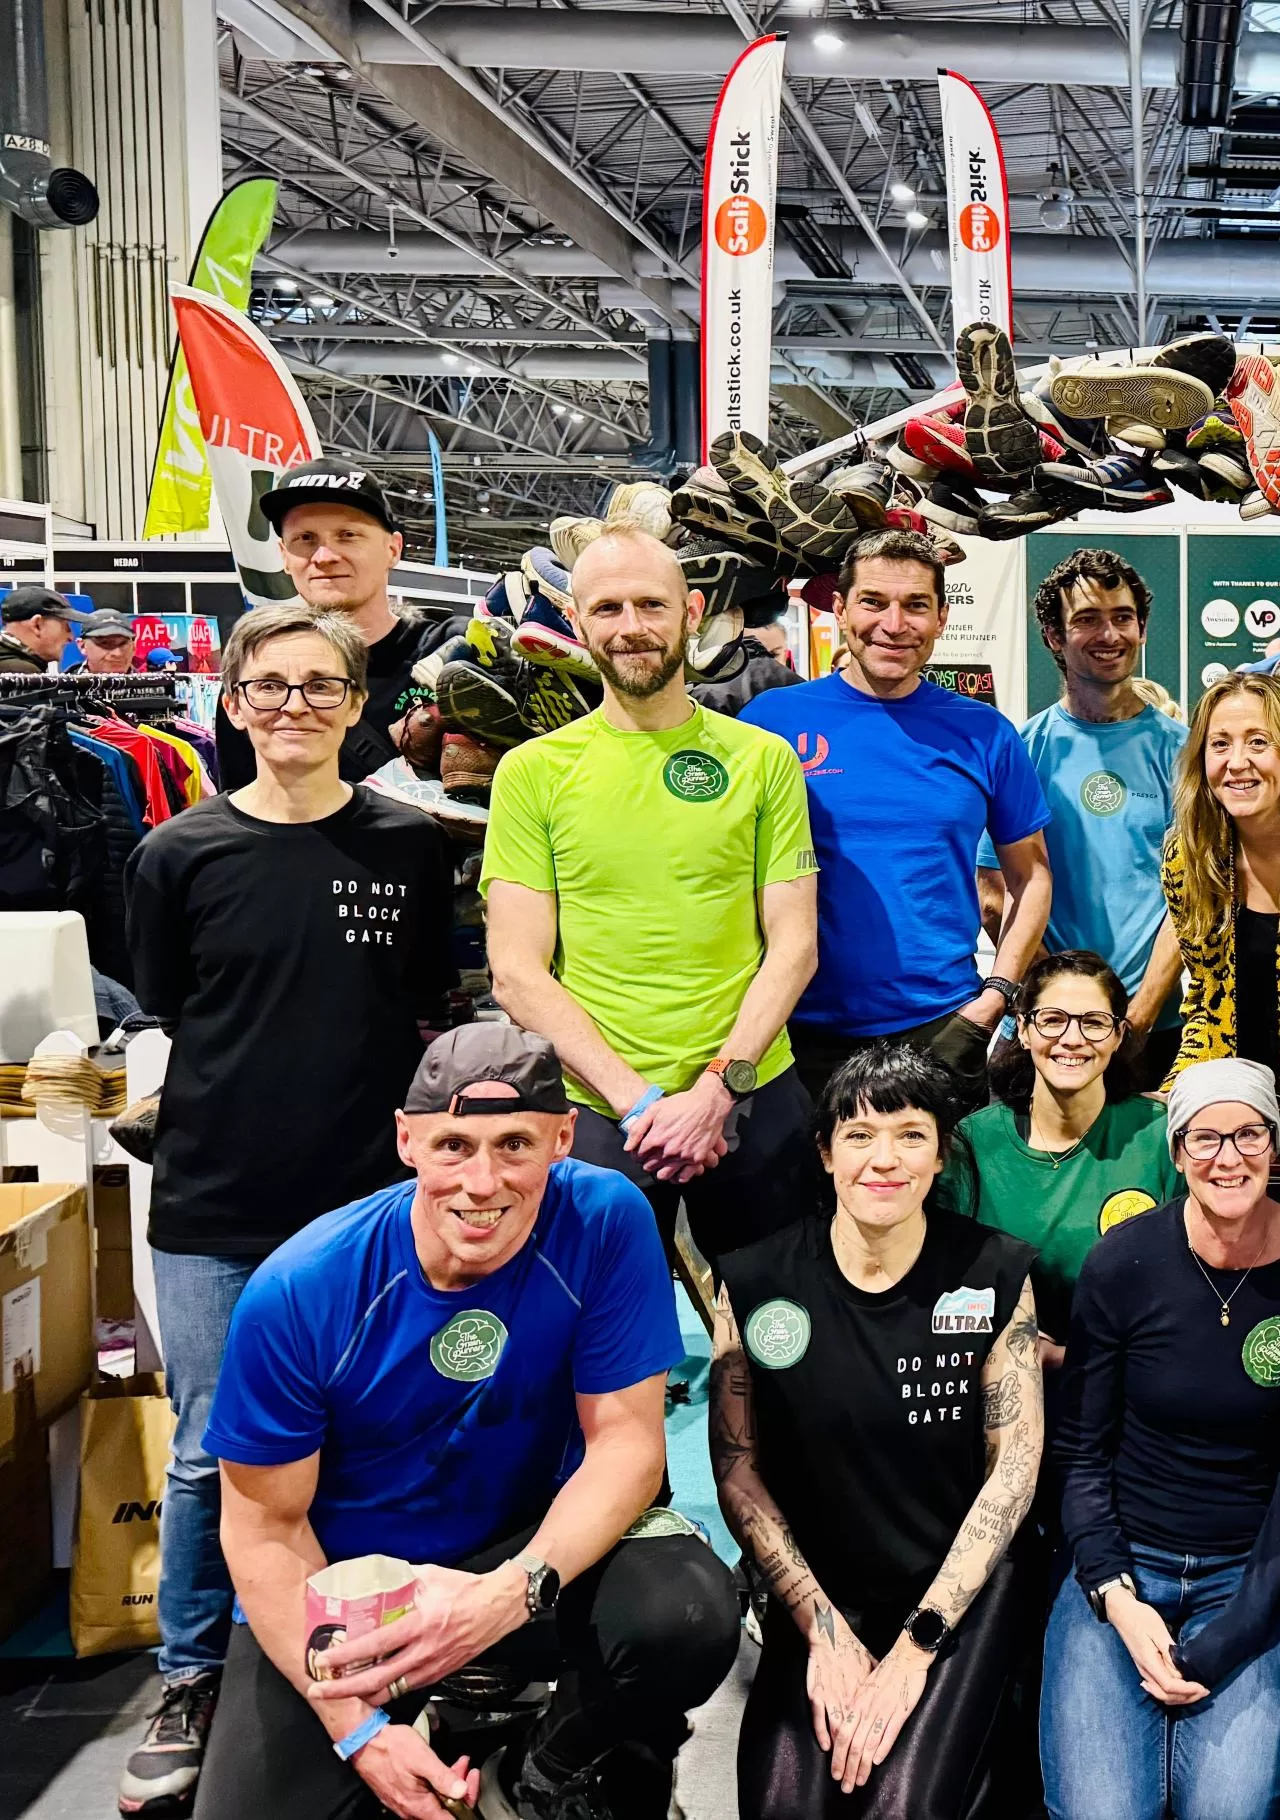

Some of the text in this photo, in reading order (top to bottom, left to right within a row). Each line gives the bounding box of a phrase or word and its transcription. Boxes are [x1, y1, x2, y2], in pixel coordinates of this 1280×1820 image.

[332, 879, 407, 897] DO NOT
[338, 904, 401, 922] BLOCK
[345, 929, 393, 945] GATE
[967, 1303, 988, 1311] INTO
[933, 1315, 991, 1331] ULTRA
[897, 1356, 922, 1374] DO
[936, 1351, 974, 1368] NOT
[901, 1379, 969, 1399] BLOCK
[908, 1406, 962, 1425] GATE
[977, 1497, 1020, 1520] TROUBLE
[962, 1522, 987, 1540] FIND
[121, 1593, 154, 1606] RUN
